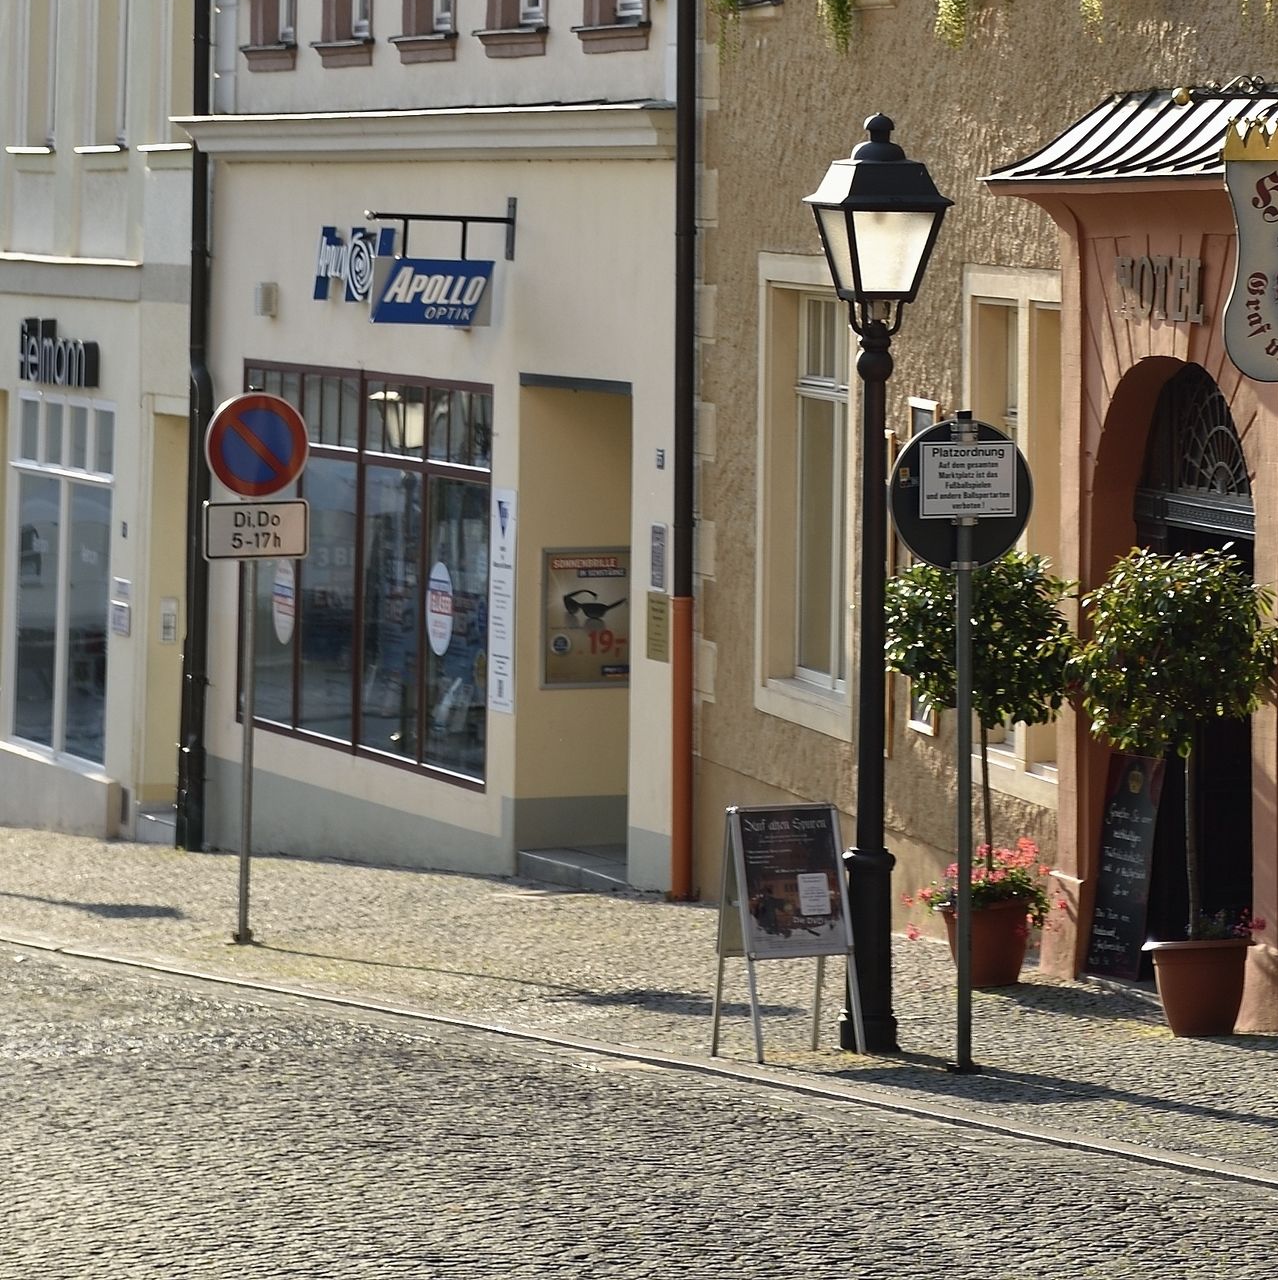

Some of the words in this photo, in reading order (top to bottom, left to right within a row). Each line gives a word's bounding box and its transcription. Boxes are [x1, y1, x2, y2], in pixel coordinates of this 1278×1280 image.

[383, 266, 488, 305] APOLLO
[1114, 255, 1204, 326] HOTEL
[1245, 271, 1269, 339] Graf
[424, 306, 474, 321] OPTIK
[932, 447, 1005, 459] Platzordnung
[938, 461, 951, 469] Auf
[952, 461, 966, 469] dem
[967, 461, 999, 470] gesamten
[938, 471, 975, 480] Marktplatz
[926, 492, 938, 500] und
[940, 491, 961, 499] andere
[963, 491, 1010, 500] Ballsportarten
